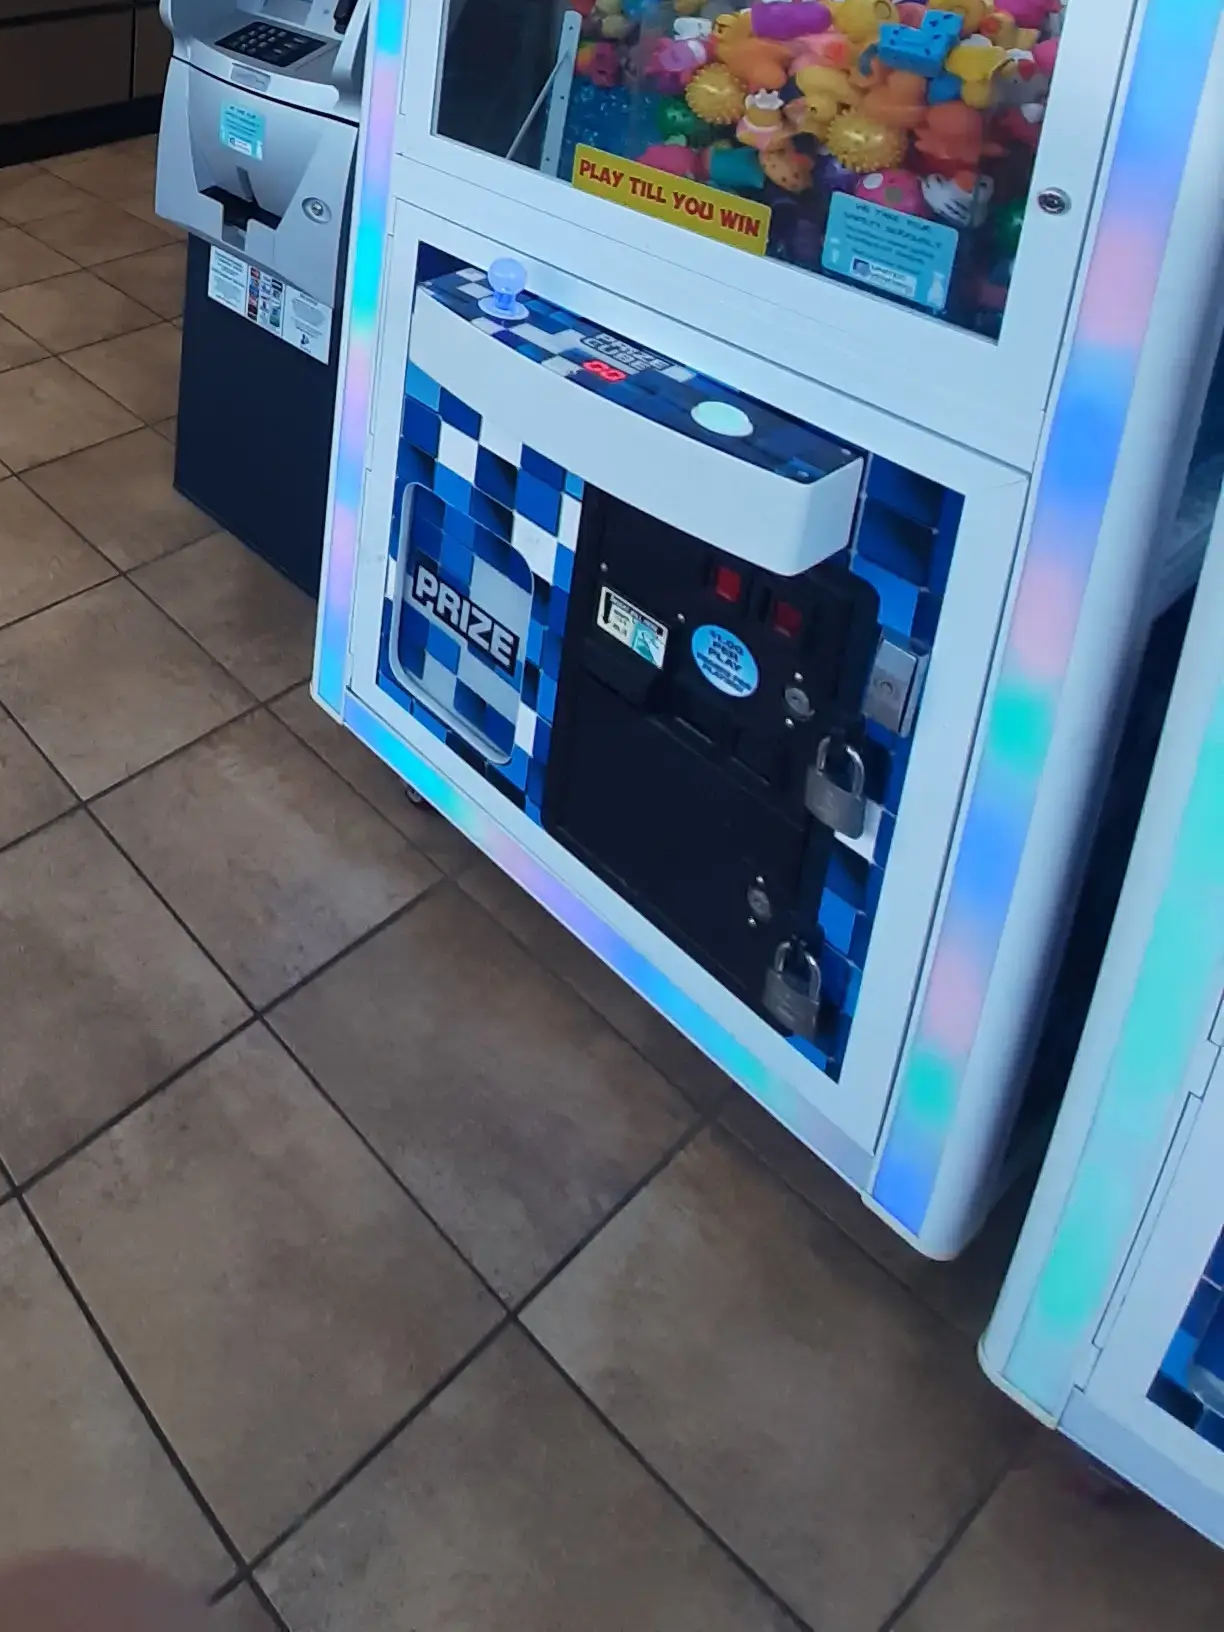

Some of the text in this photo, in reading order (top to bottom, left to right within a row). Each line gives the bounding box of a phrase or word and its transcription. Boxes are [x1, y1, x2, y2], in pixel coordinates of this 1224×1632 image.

[579, 158, 761, 237] PLAY TILL YOU WIN
[583, 337, 651, 372] CUBE
[595, 333, 671, 370] PRIZE
[415, 564, 515, 668] PRIZE
[708, 647, 743, 672] PLAY
